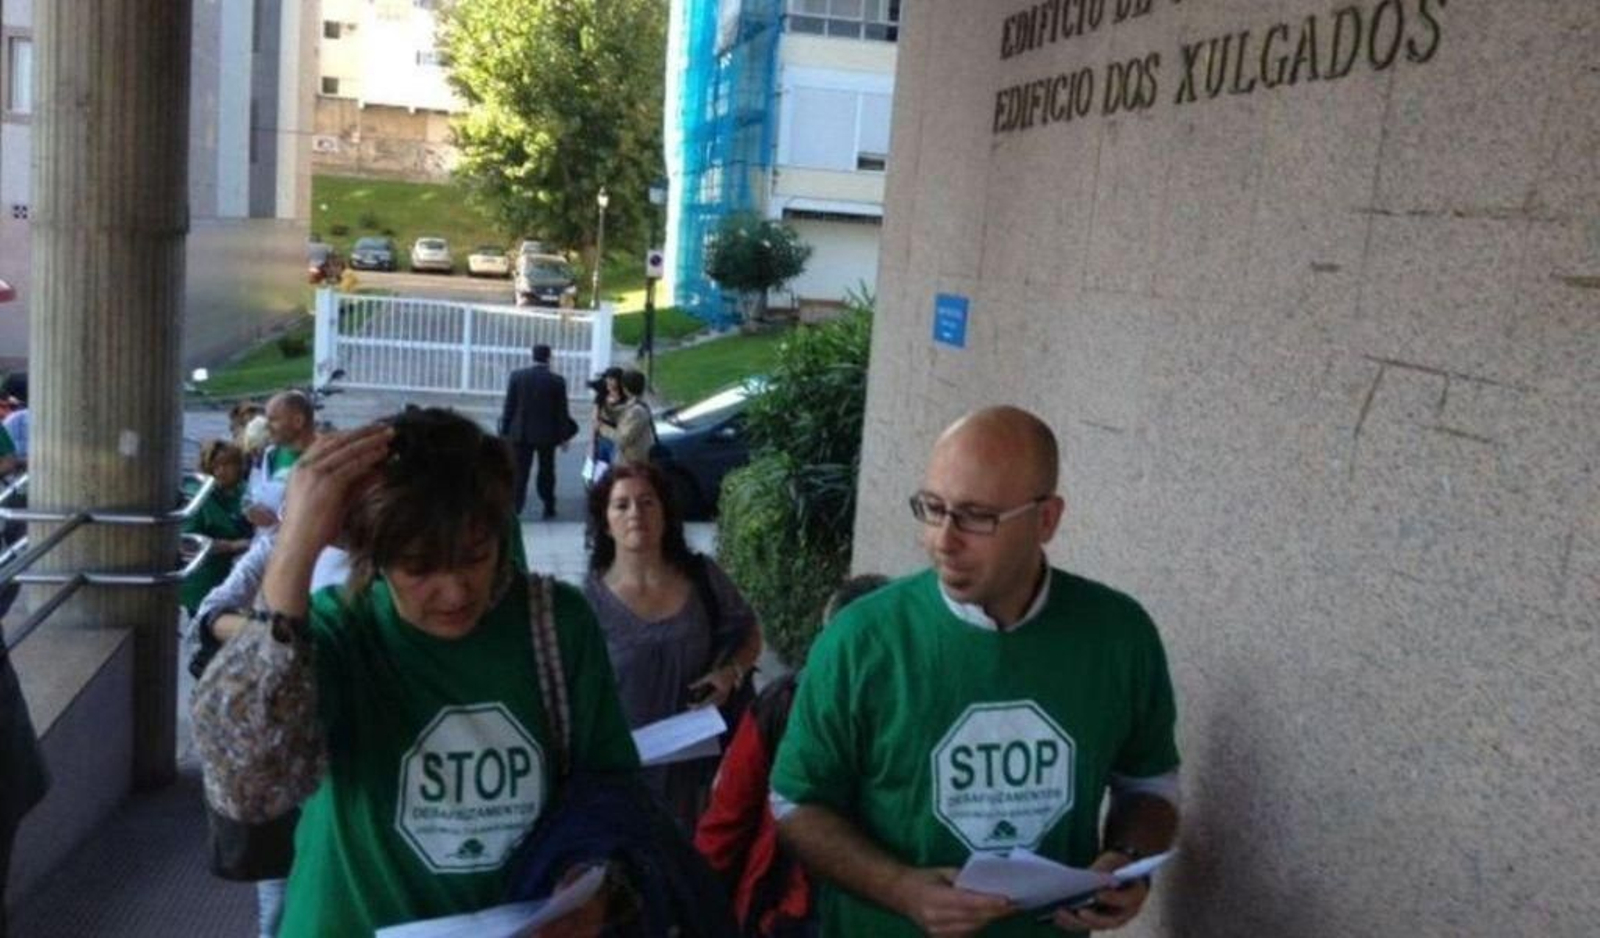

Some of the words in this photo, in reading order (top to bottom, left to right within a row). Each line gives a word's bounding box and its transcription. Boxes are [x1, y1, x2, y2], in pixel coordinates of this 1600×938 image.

[1000, 0, 1104, 59] EDIFICIO
[993, 68, 1094, 133] EDIFICIO
[1102, 53, 1161, 116] DOS
[1174, 0, 1447, 104] XULGADOS
[420, 746, 531, 803] STOP
[950, 739, 1058, 790] STOP
